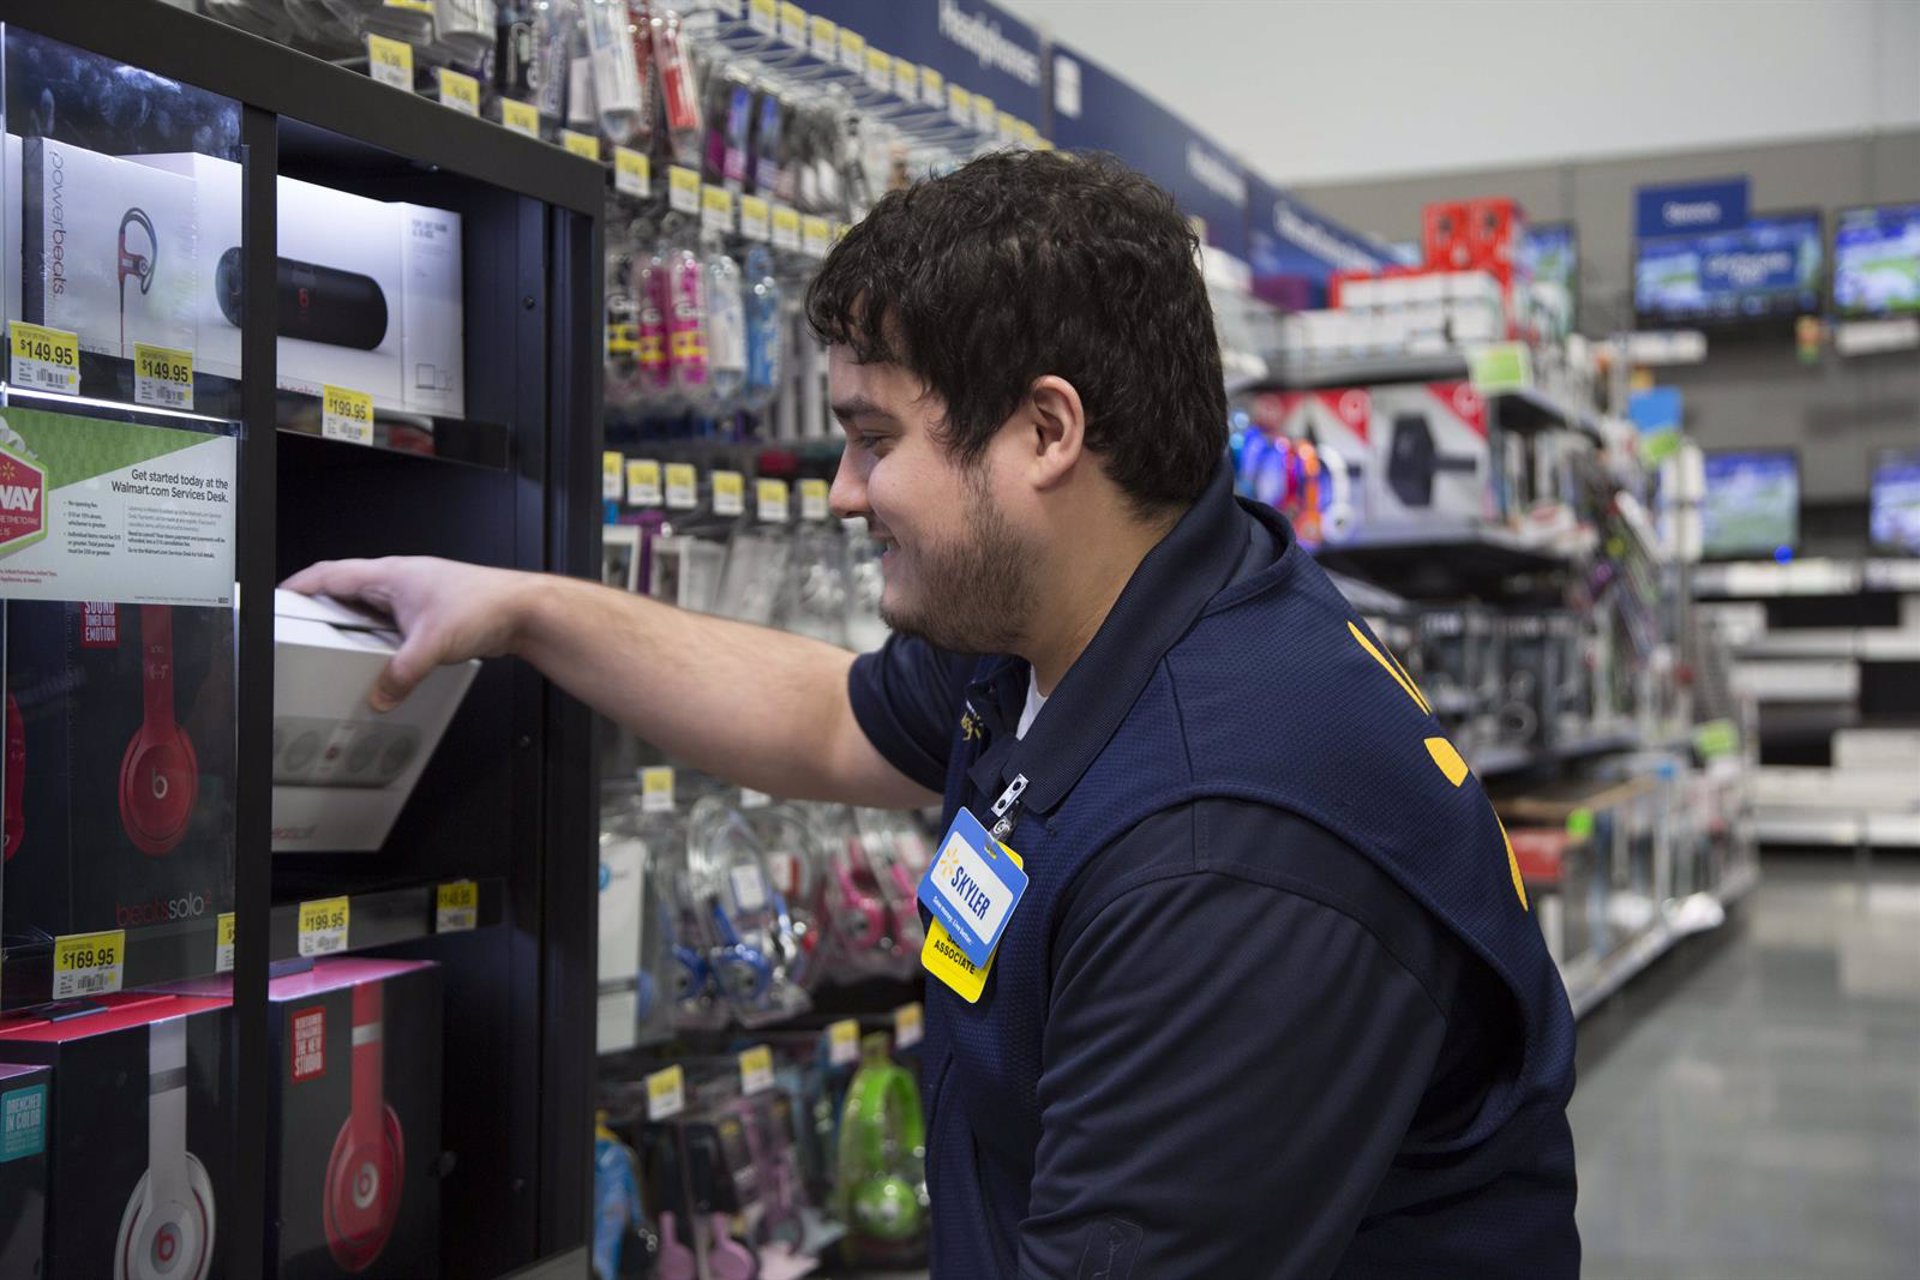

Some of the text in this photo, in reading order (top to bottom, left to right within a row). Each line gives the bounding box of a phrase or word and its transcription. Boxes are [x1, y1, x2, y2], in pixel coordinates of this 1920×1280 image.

[50, 151, 67, 295] powerbeats
[20, 339, 73, 365] $149.95
[142, 359, 189, 382] $149.95
[329, 398, 367, 420] $199.95
[131, 468, 229, 490] Get started today at the
[111, 480, 229, 503] Walmart.com Services Desk.
[85, 626, 116, 642] EMOTION
[950, 866, 991, 921] SKYLER
[305, 912, 345, 931] $199.95
[62, 947, 114, 970] $169.95
[934, 940, 977, 975] ASSOCIATE
